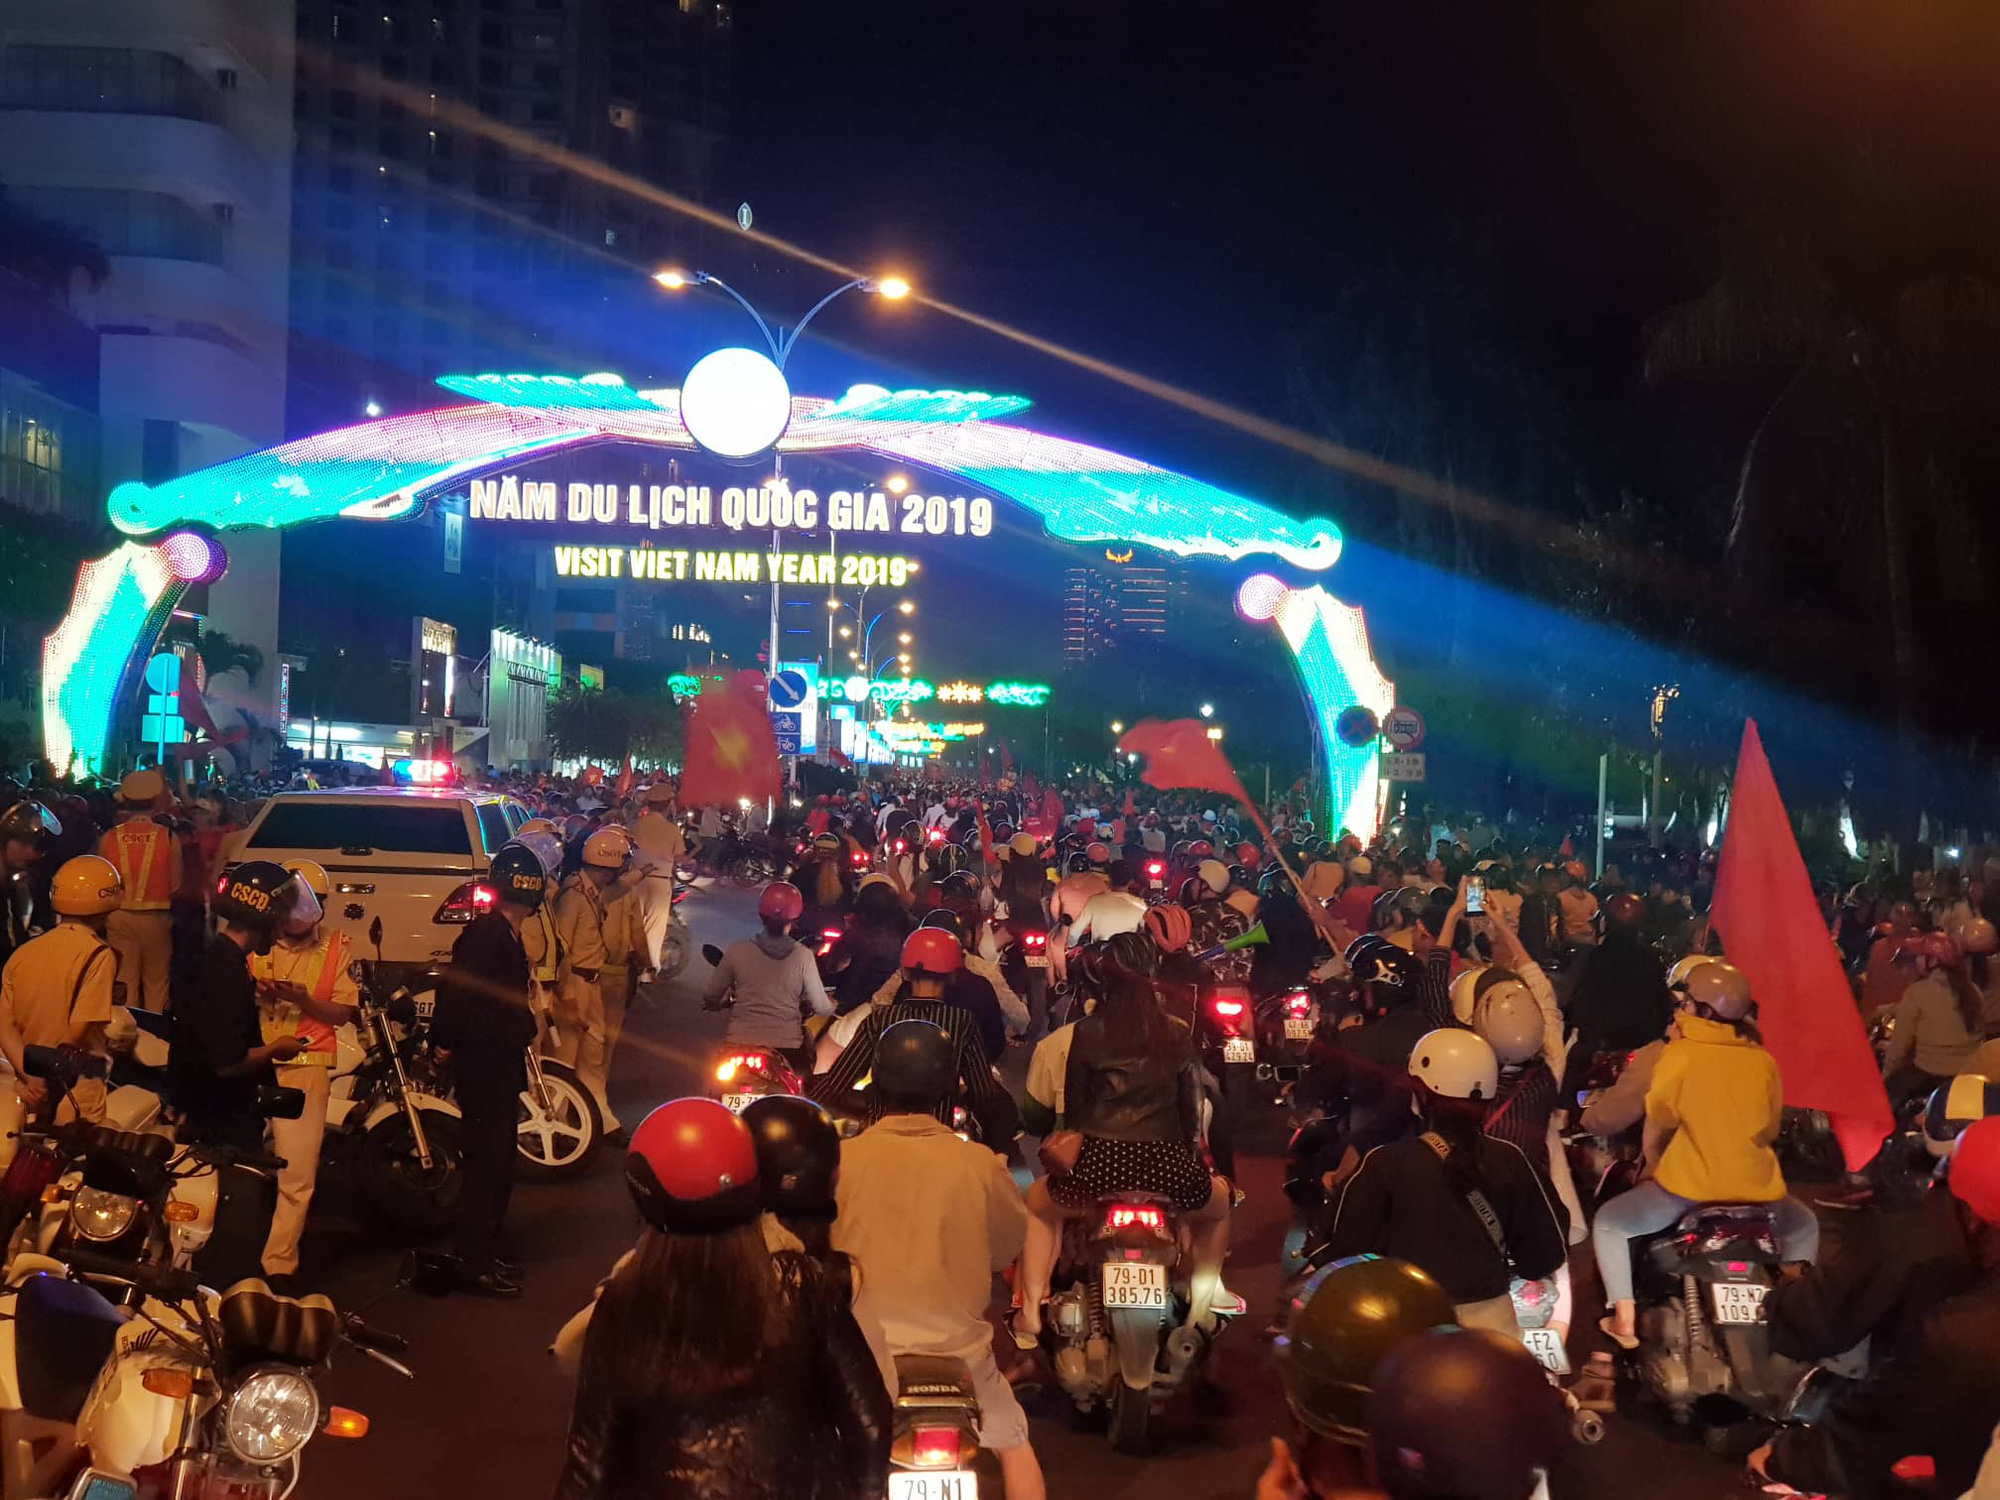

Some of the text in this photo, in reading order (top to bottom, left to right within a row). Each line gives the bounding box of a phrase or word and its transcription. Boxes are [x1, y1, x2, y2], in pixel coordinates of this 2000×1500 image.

[470, 476, 992, 537] NĂM DU LỊCH QUỐC GIA 2019
[554, 546, 907, 587] VISIT VIET NAM YEAR 2019
[231, 882, 270, 911] CSCD
[1113, 1267, 1154, 1285] 79-D1
[1109, 1286, 1162, 1304] 385.76
[907, 1384, 961, 1394] HONDA
